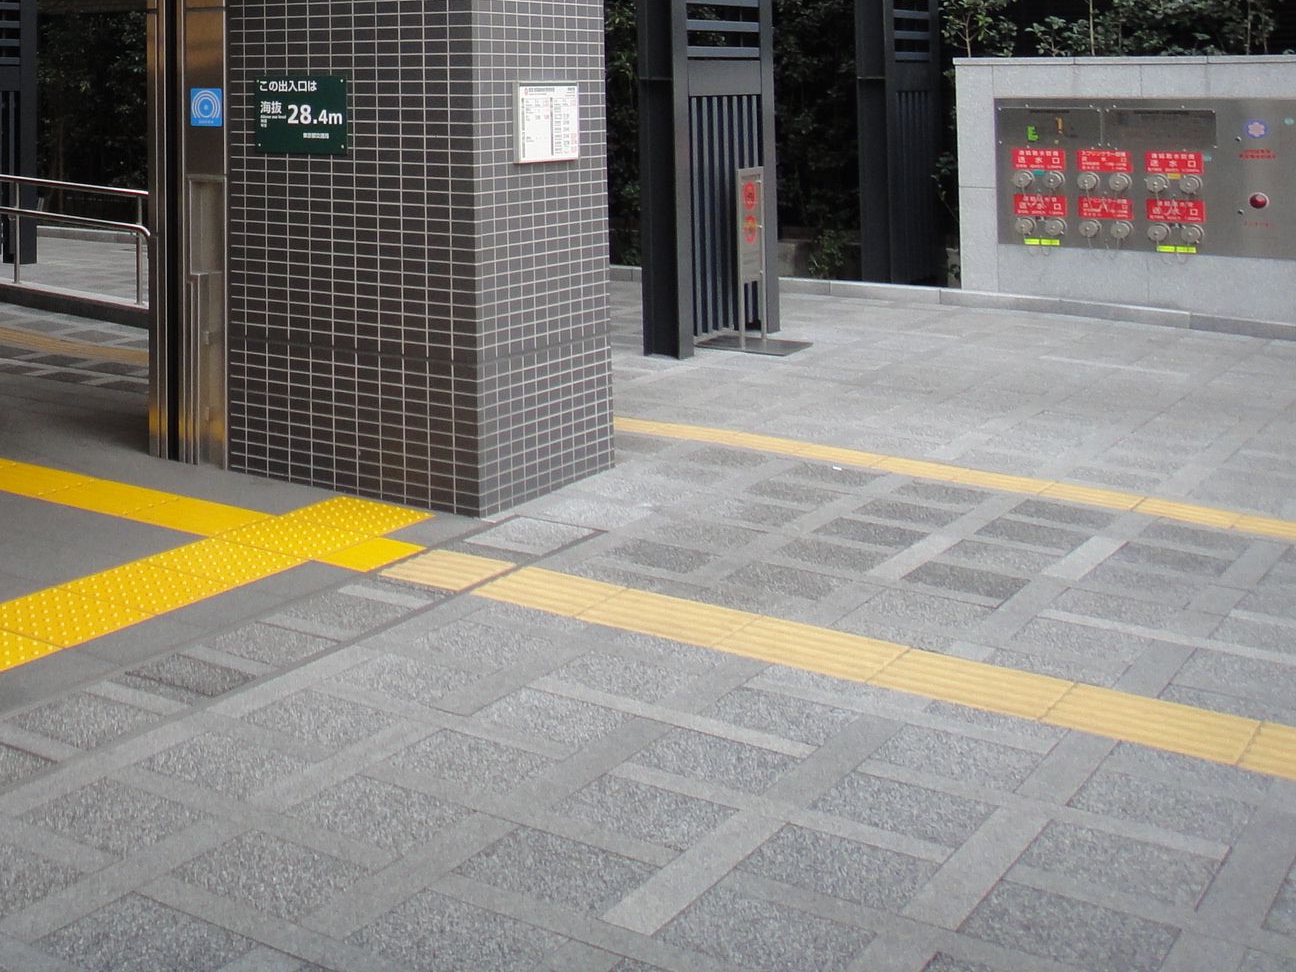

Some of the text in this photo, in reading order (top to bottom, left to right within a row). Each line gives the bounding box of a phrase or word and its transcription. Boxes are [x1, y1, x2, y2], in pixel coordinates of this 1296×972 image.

[259, 80, 318, 92] この出入口は
[260, 100, 283, 114] 海抜
[287, 104, 343, 125] 28.4m
